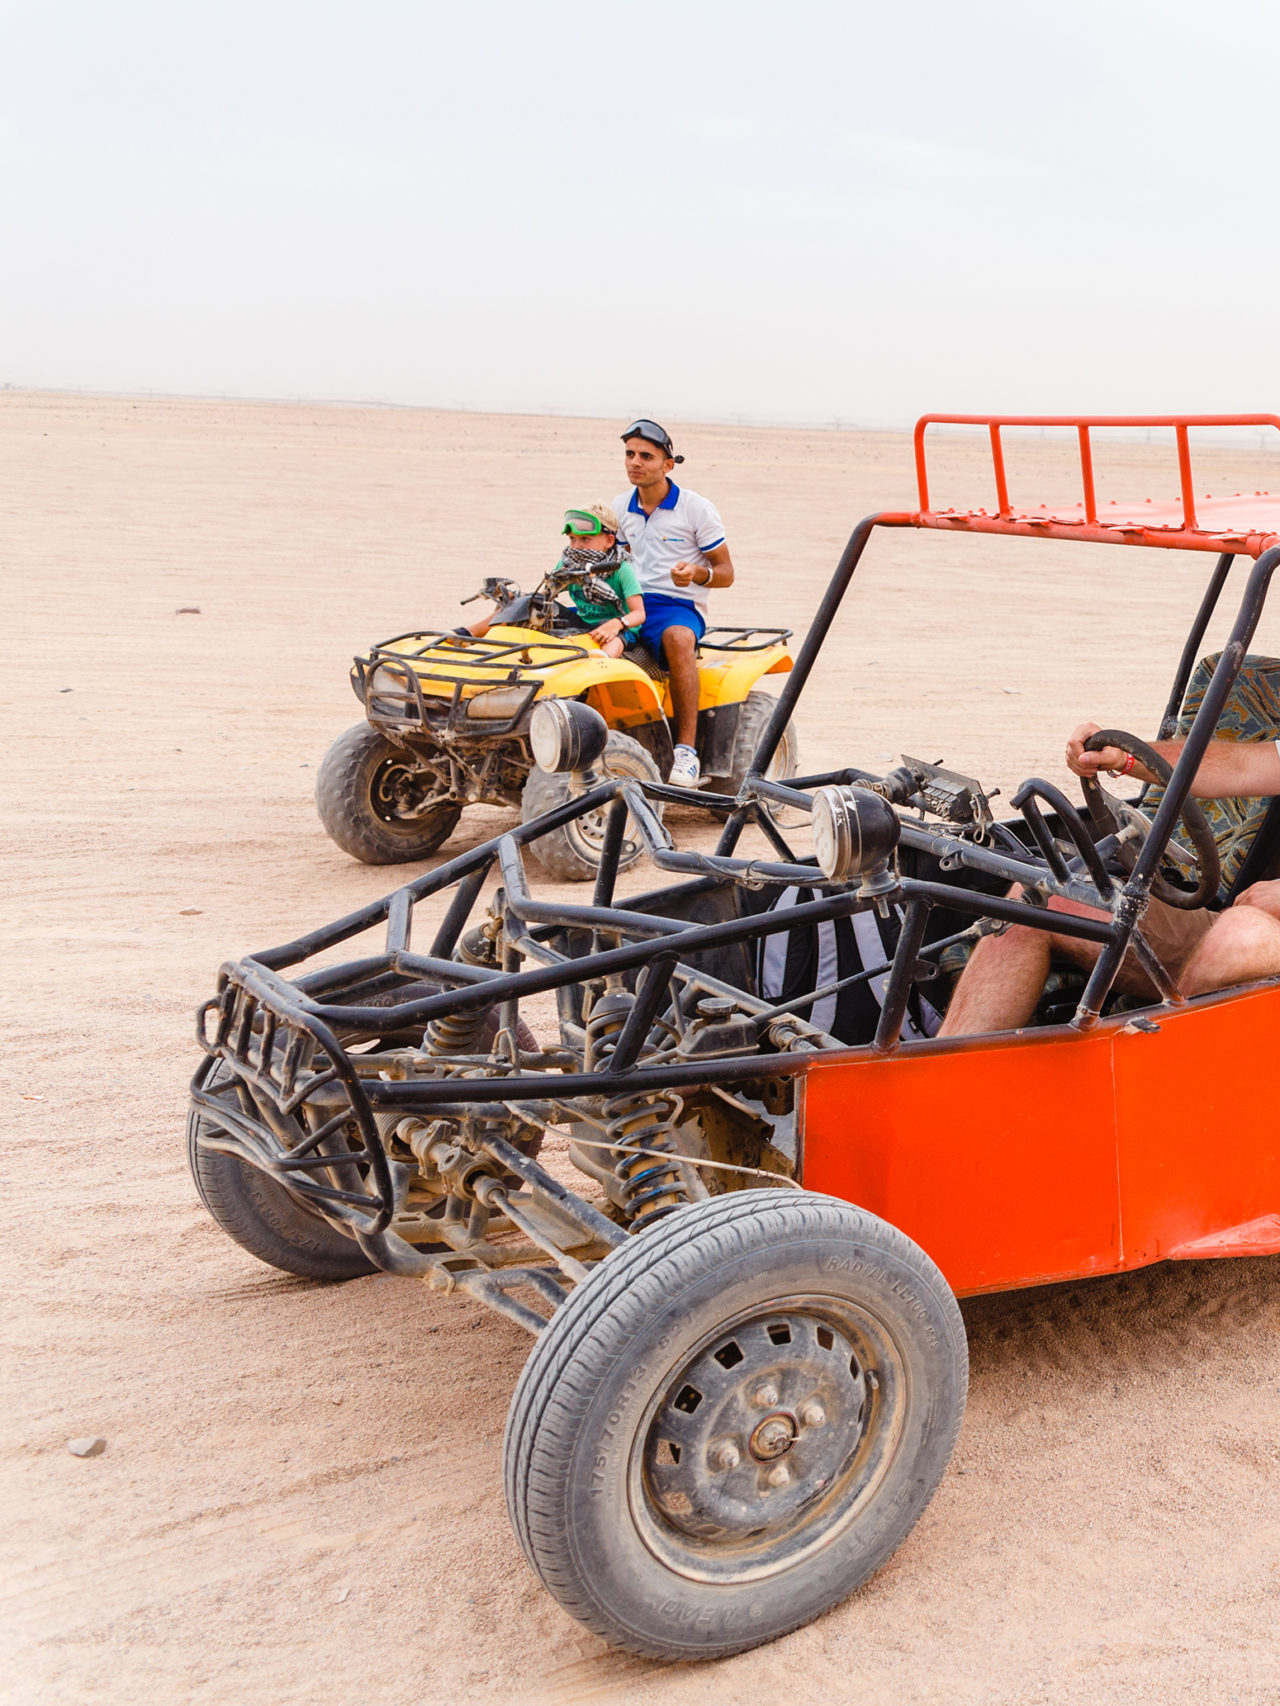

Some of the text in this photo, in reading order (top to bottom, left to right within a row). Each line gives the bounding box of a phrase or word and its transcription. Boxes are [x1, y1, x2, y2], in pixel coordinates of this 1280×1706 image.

[827, 1255, 889, 1282] RADIAL
[891, 1279, 929, 1321] LL700
[588, 1364, 648, 1498] 175/70R13
